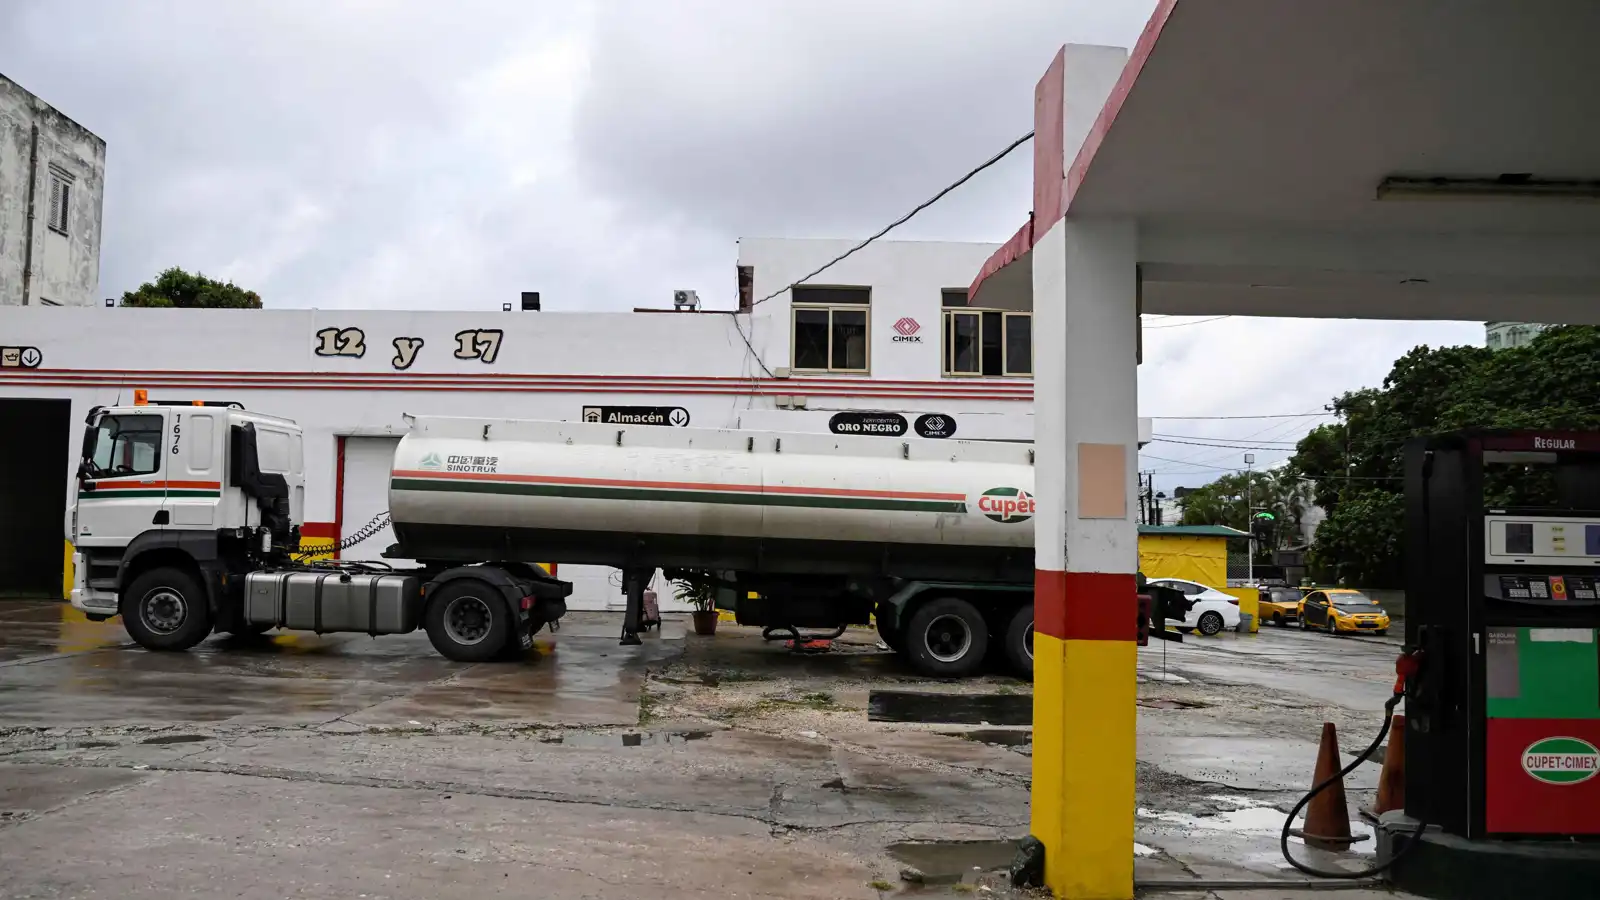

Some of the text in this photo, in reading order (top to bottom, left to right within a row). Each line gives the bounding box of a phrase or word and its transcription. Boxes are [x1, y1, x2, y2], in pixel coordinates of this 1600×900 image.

[315, 327, 503, 370] 12 y 17
[607, 411, 664, 423] Almacén
[171, 413, 181, 455] 1676
[836, 423, 901, 433] ORO NEGRO
[446, 464, 497, 473] SINOTRUK
[1526, 756, 1598, 769] CUPET-CIMEX
